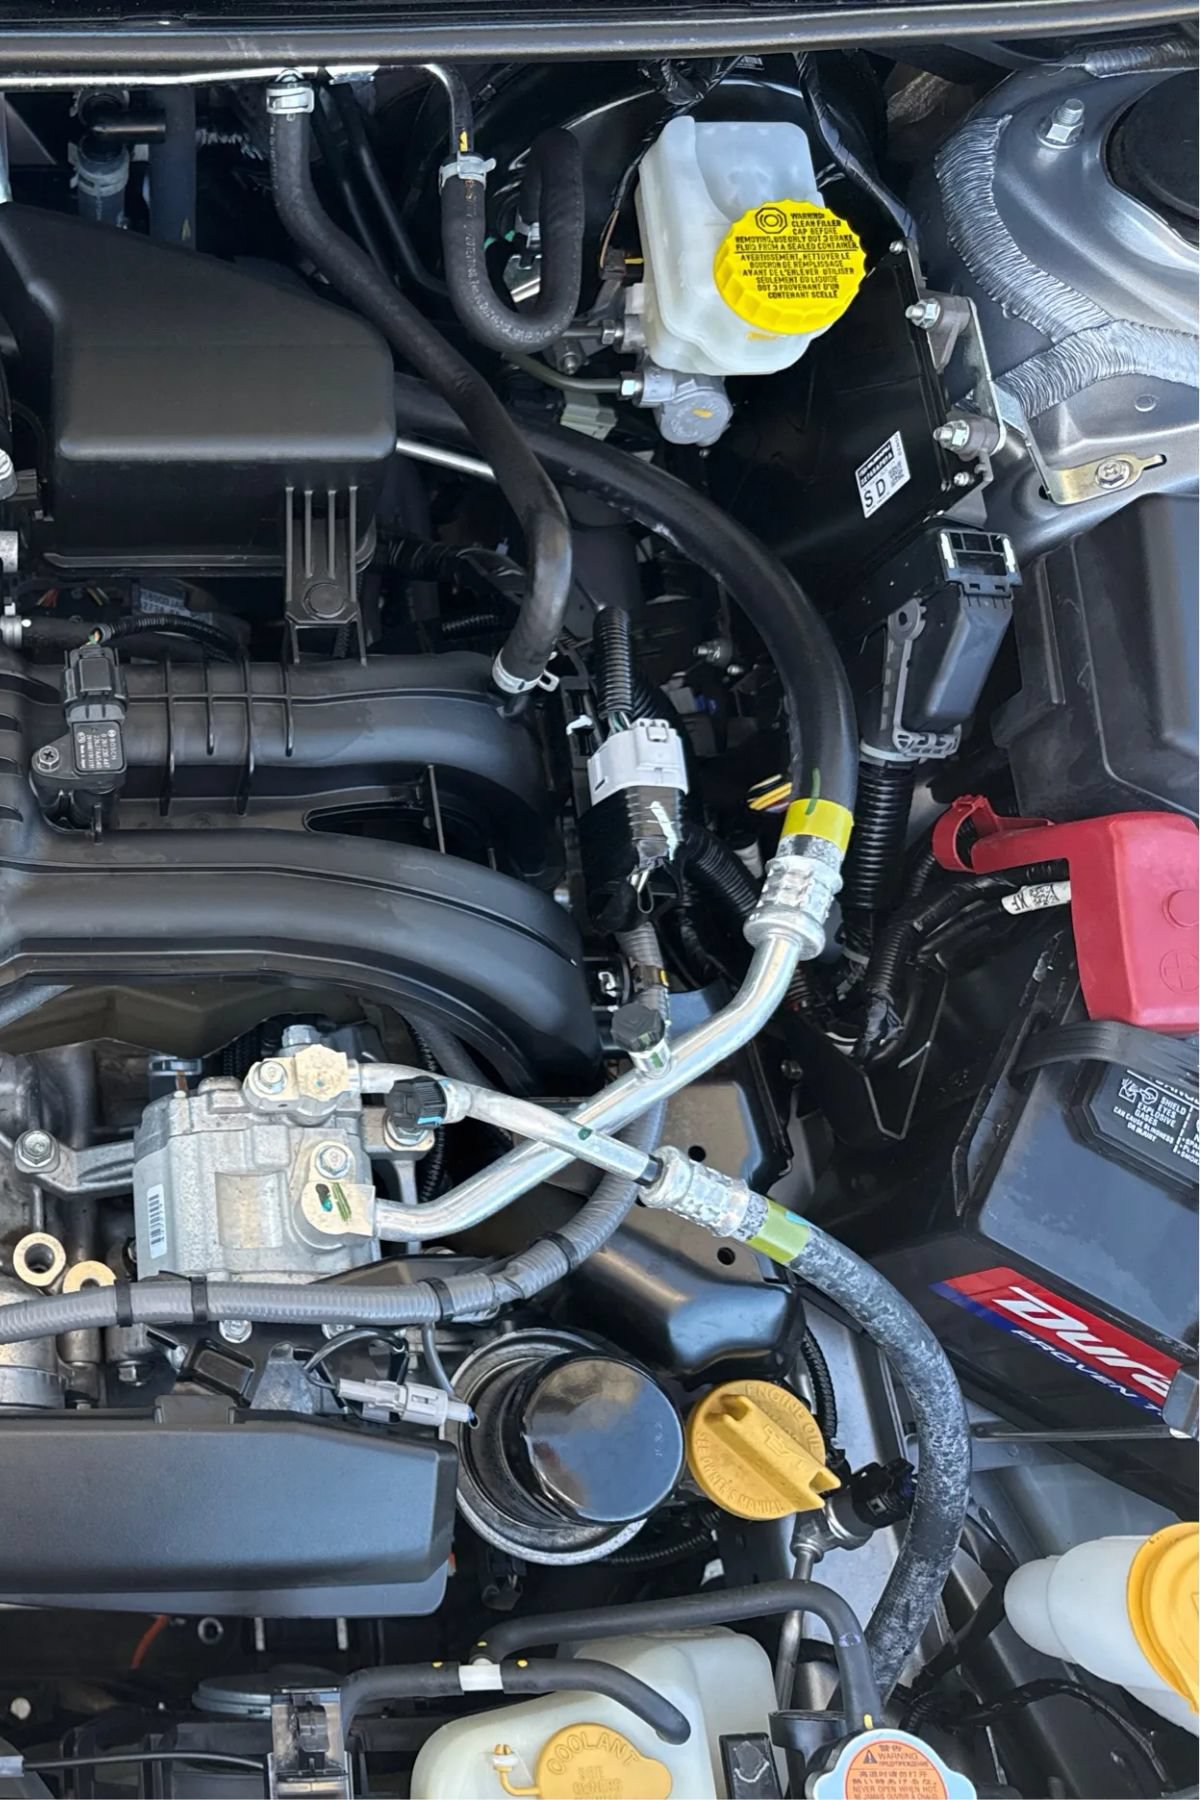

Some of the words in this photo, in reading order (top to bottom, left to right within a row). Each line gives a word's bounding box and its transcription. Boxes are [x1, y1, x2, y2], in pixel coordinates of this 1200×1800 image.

[864, 490, 873, 508] S
[876, 478, 886, 498] D
[1134, 1109, 1158, 1126] GASES
[1137, 1102, 1177, 1128] EXPLOSIVE
[1157, 1104, 1177, 1119] EYES
[1160, 1097, 1186, 1115] SHIELD
[1113, 1106, 1126, 1118] CAN
[1126, 1113, 1143, 1128] CAUSE
[1144, 1123, 1174, 1144] BLINDNESS
[1127, 1122, 1136, 1131] OR
[1135, 1126, 1157, 1142] INJURY
[1010, 1330, 1139, 1398] PROVEN
[745, 1384, 804, 1418] ENGINE
[803, 1423, 820, 1452] OIL
[696, 1432, 709, 1456] SEE
[703, 1457, 736, 1501] OWNER'S
[739, 1494, 784, 1514] MANUAL
[546, 1731, 638, 1775] COOLANT
[578, 1766, 604, 1780] SEE
